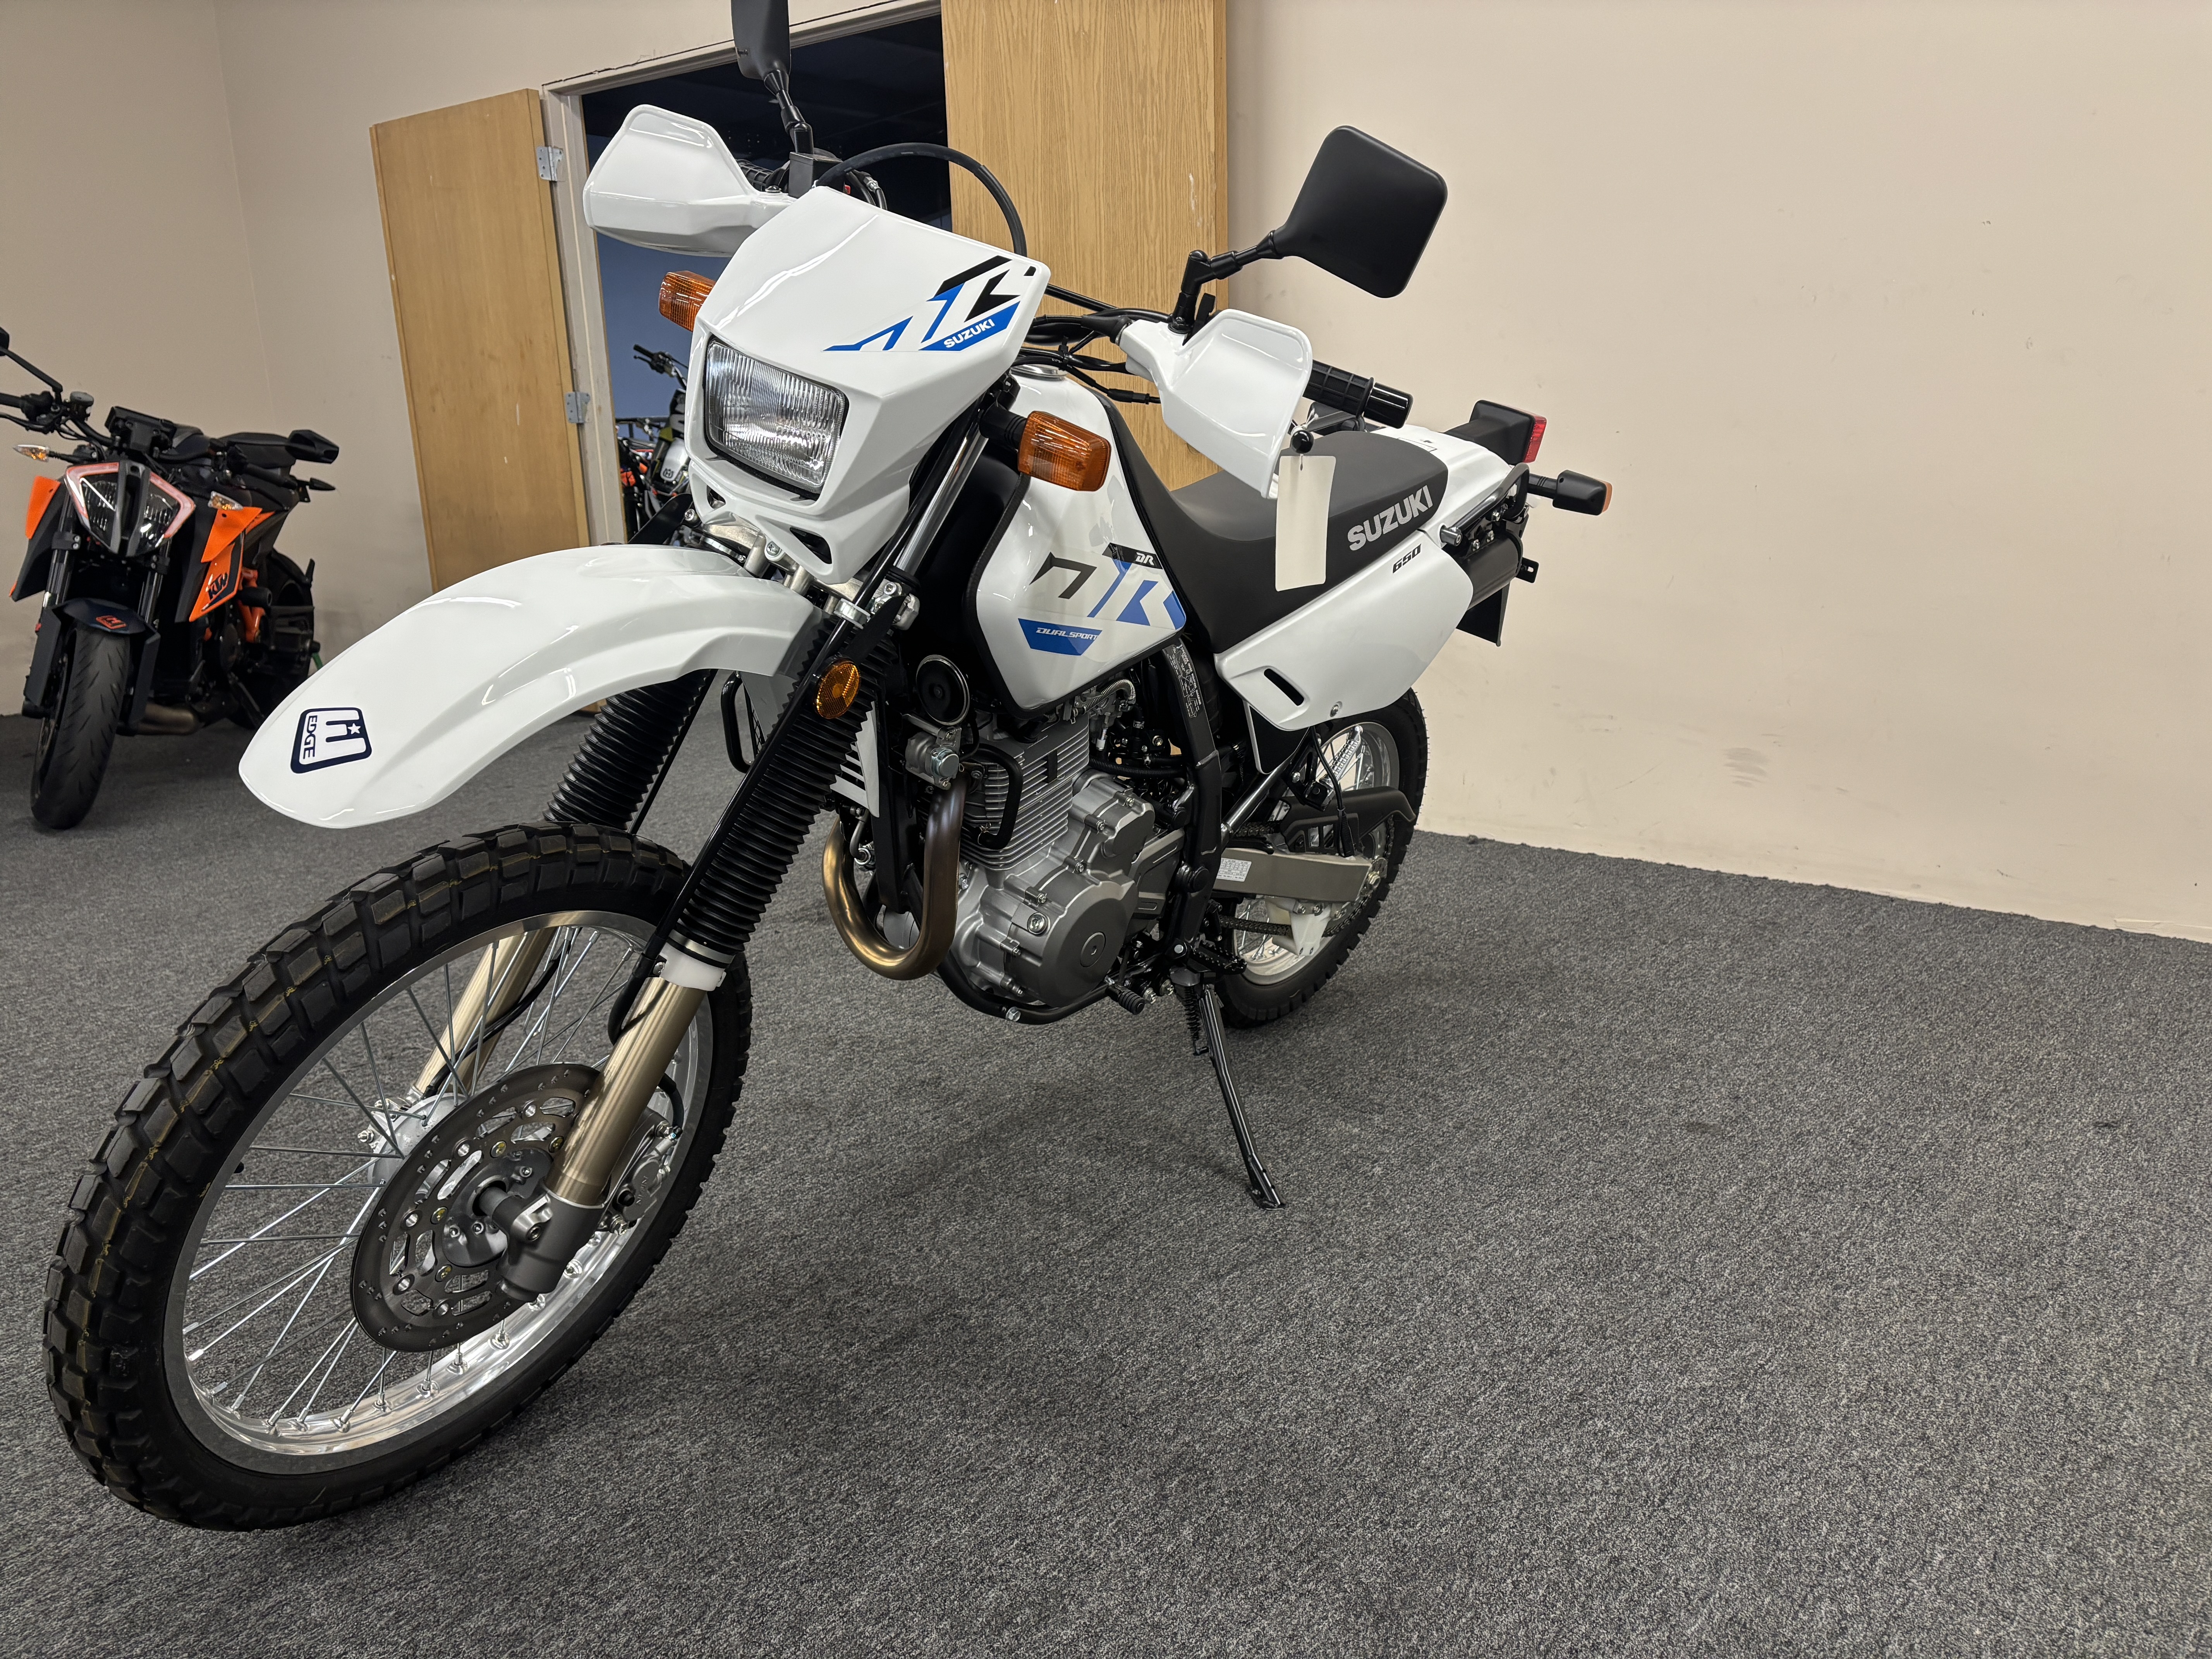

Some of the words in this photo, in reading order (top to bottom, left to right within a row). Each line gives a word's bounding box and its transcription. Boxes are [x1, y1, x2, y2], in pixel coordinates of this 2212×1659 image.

[943, 318, 995, 348] SUZUKI
[1347, 485, 1433, 551] SUZUKI
[1135, 552, 1154, 565] DR
[1392, 543, 1422, 574] 650
[208, 572, 228, 601] KTM
[303, 715, 318, 759] EDGE
